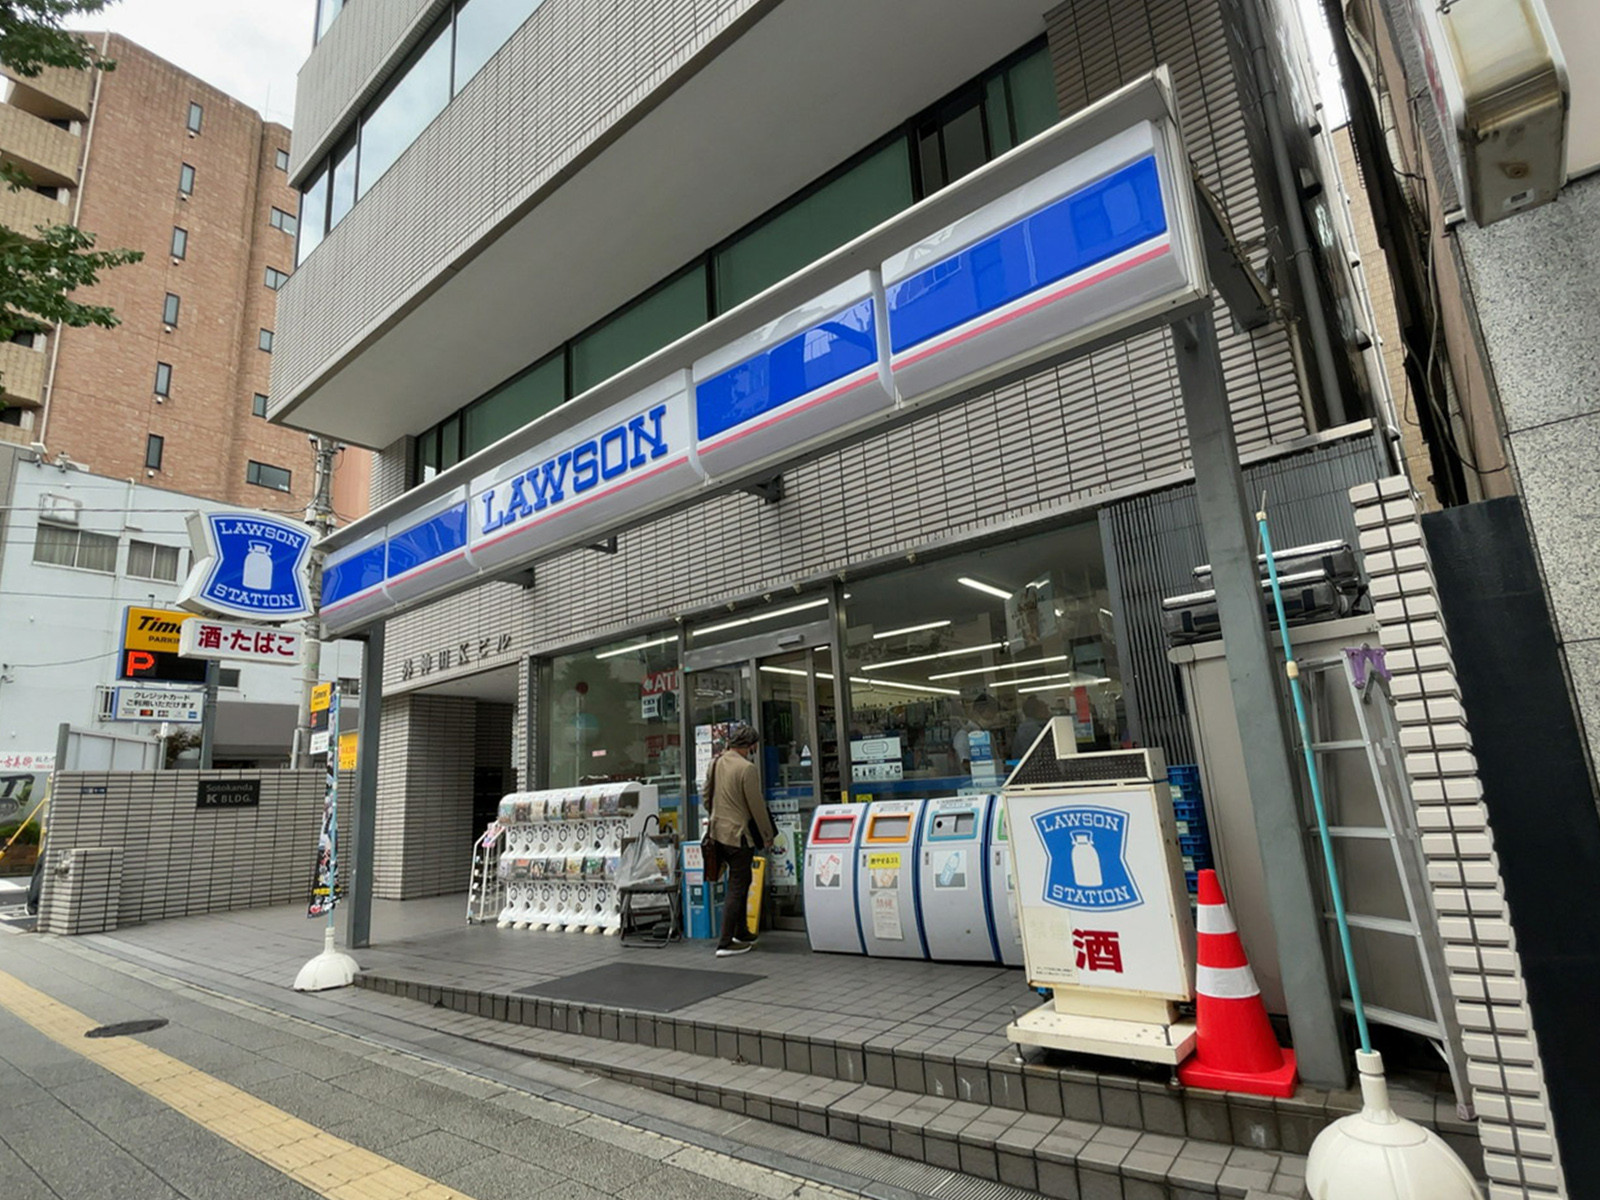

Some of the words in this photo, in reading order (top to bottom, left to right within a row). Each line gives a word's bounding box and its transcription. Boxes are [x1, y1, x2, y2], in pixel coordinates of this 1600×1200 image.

[481, 404, 669, 535] LAWSON
[219, 522, 302, 549] LAWSON
[213, 583, 296, 608] STATION
[126, 651, 155, 676] P
[126, 699, 196, 709] ご利用いただけます
[134, 691, 191, 701] クレジットカード
[206, 793, 218, 804] K
[1041, 812, 1120, 833] LAWSON
[1052, 883, 1130, 905] STATION
[1072, 928, 1124, 974] 酒
